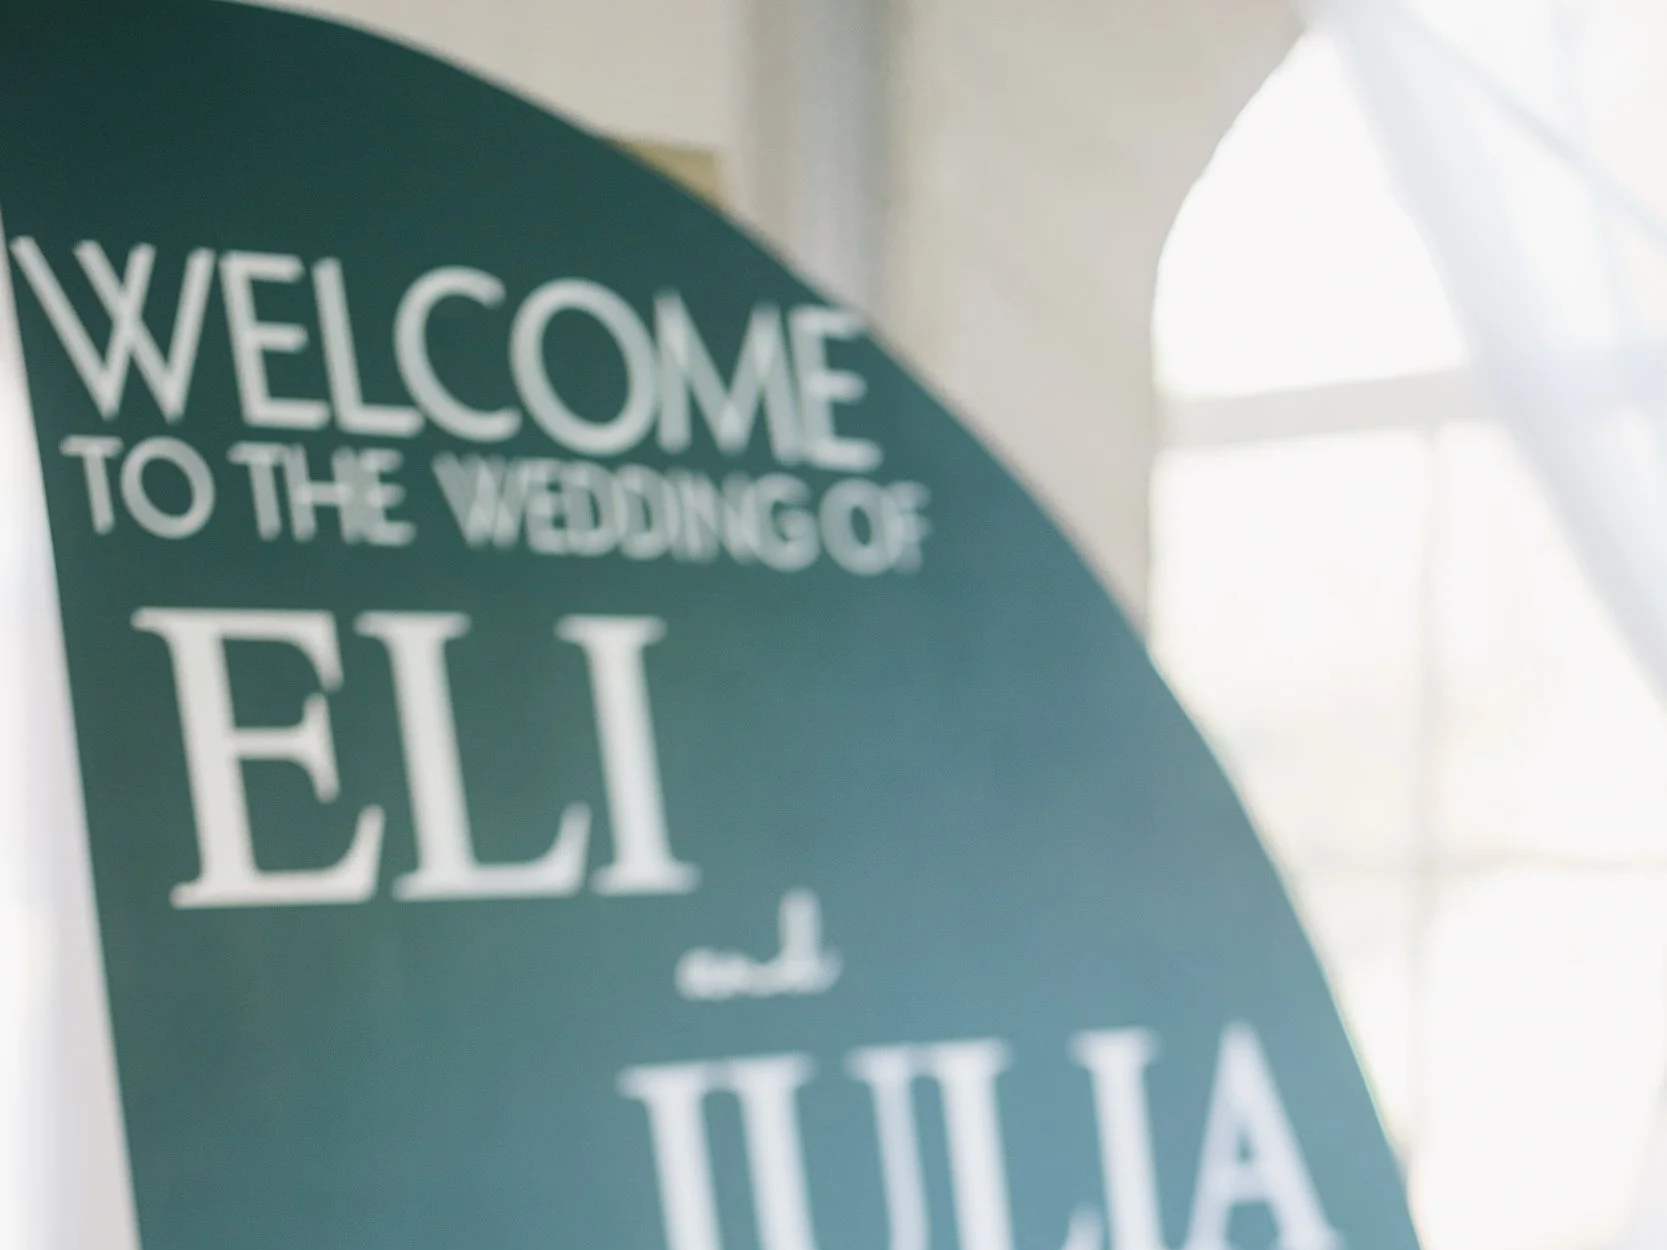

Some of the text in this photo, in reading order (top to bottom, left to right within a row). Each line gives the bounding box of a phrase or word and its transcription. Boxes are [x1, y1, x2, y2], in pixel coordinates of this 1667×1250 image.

[9, 236, 882, 472] WELCOME
[60, 436, 933, 576] TO THE WEDDING OF
[131, 607, 700, 908] ELI
[675, 886, 843, 999] and
